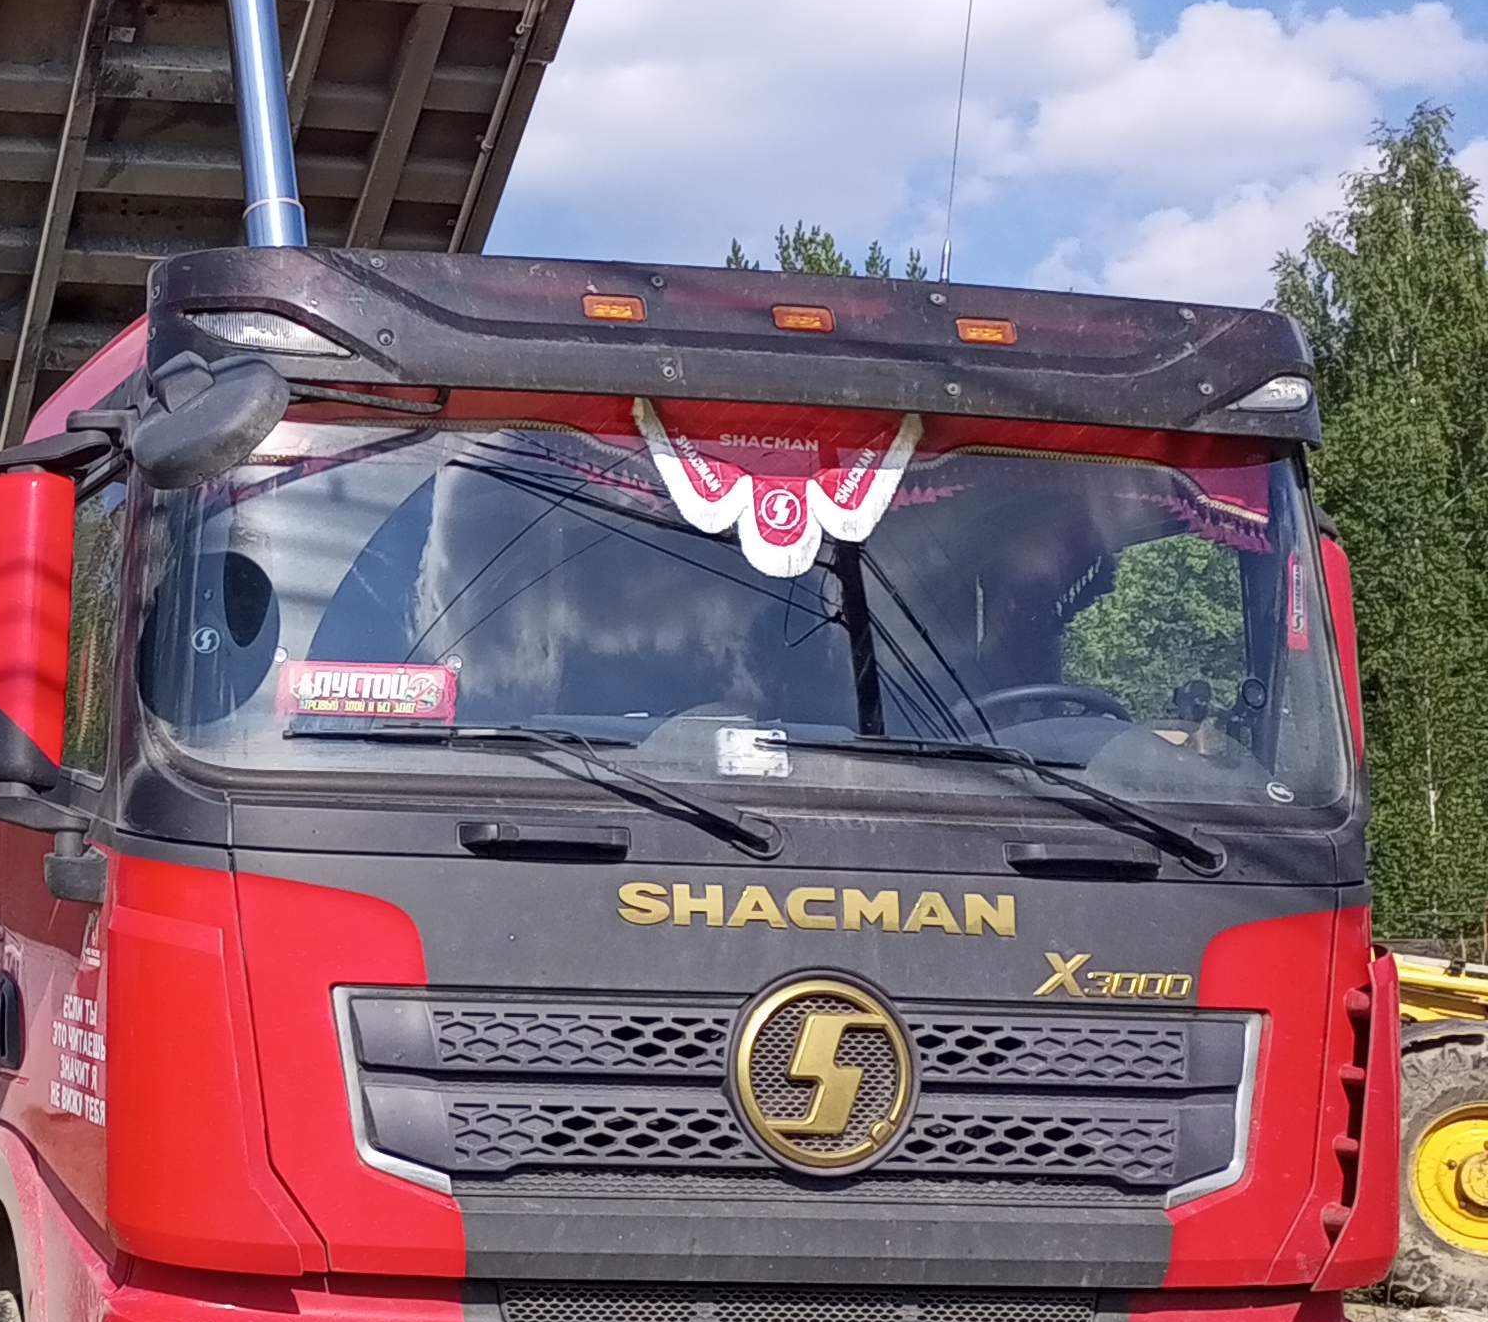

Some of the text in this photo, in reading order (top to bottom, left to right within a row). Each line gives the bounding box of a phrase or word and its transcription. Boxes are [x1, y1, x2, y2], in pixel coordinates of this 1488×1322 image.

[675, 434, 723, 493] SHACMAN
[718, 433, 819, 452] SHACMAN
[833, 448, 877, 505] SHACMAN
[312, 667, 410, 700] ПУСТОЙ
[617, 881, 1017, 938] SHACMAN
[1033, 952, 1193, 999] X3000
[63, 993, 98, 1027] ЕСЛИ ТЫ
[52, 1020, 106, 1061] ЭТО ЧИТАЕШЬ
[60, 1053, 98, 1091] ЗНАЧИТ Я
[50, 1080, 106, 1127] НЕ ВИЖУ ТЕБЯ
